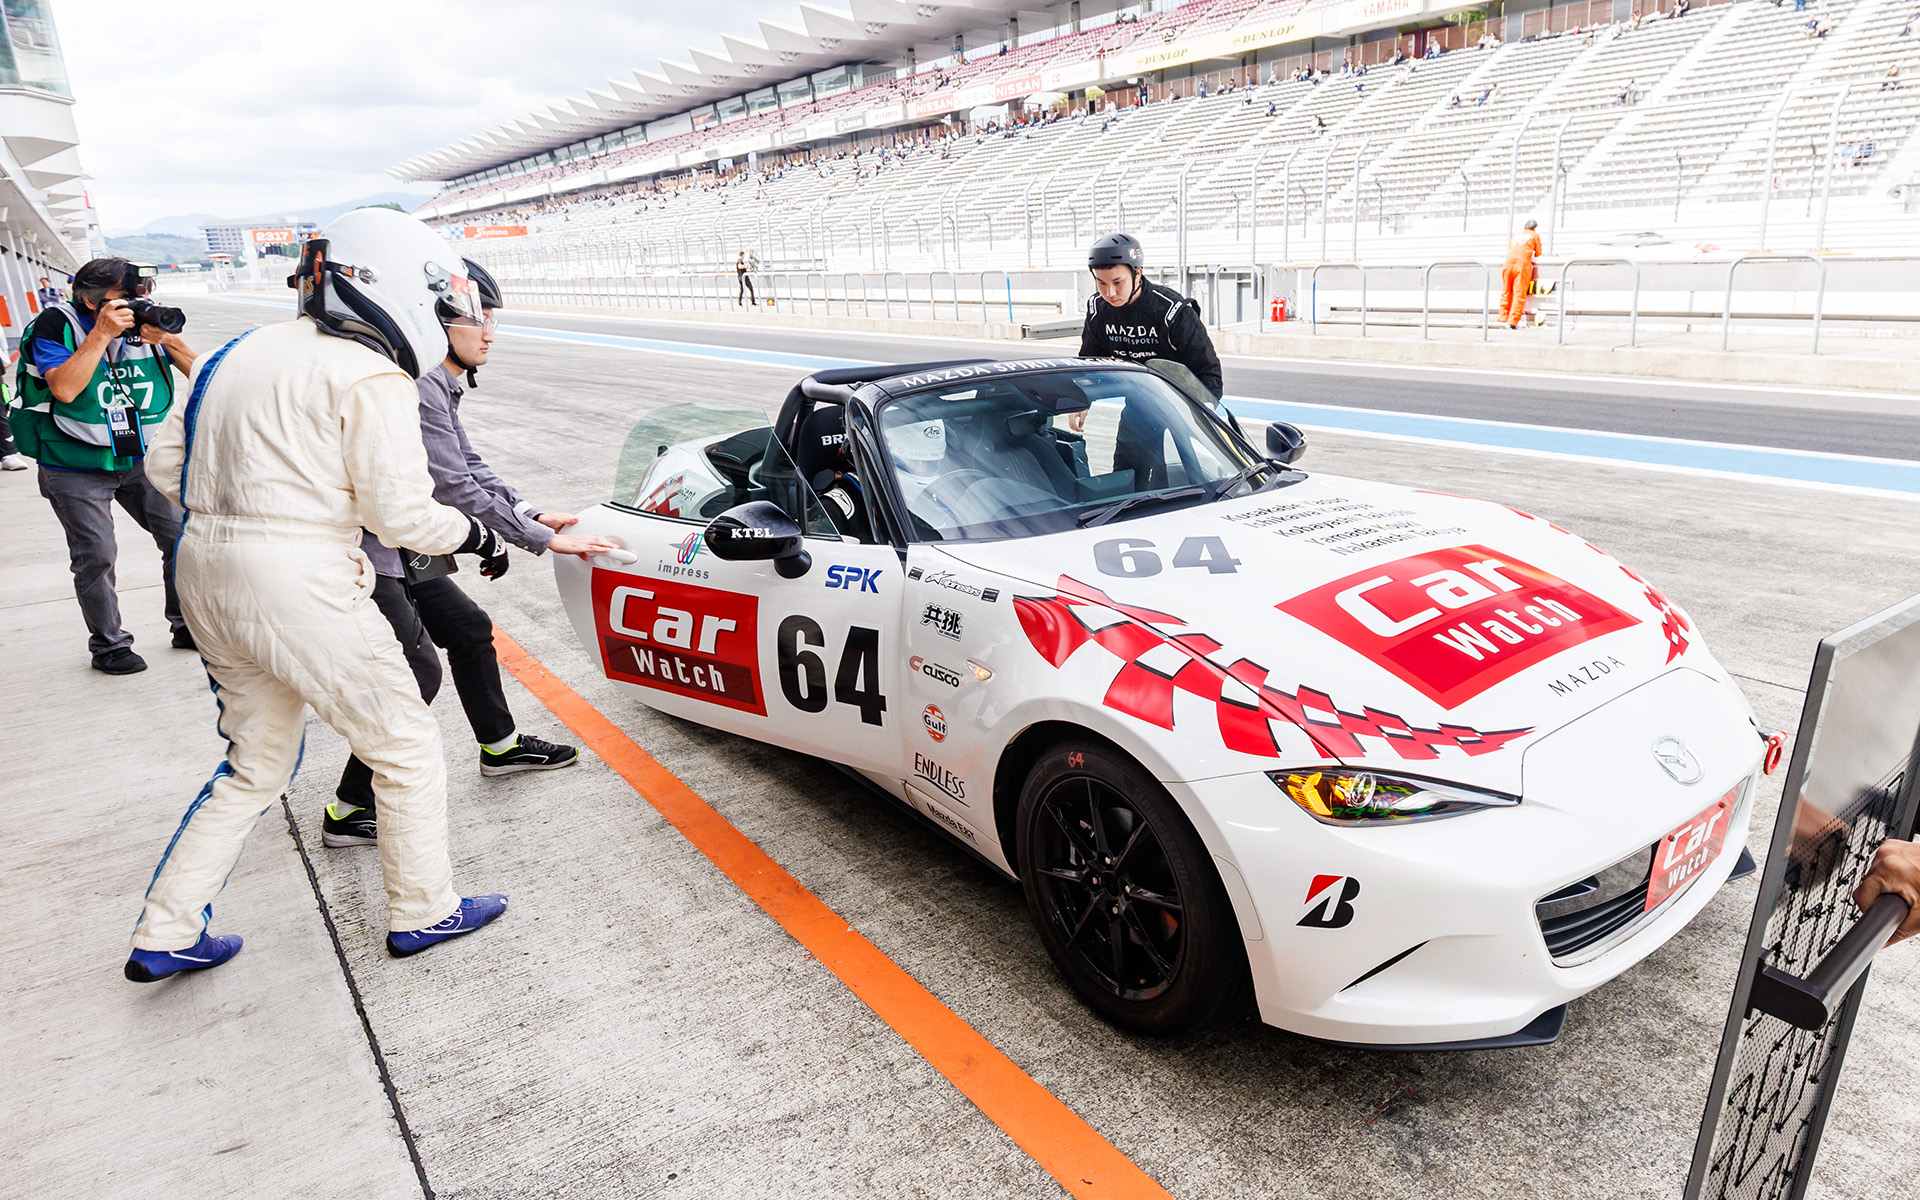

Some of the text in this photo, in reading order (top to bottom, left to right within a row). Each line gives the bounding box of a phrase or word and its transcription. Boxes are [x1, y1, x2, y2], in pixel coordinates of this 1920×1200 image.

[1362, 0, 1410, 17] YAMAHA
[1242, 24, 1295, 44] DUNLOP
[1144, 48, 1188, 65] DUNLOP
[996, 77, 1041, 99] NISSAN
[916, 97, 953, 115] NISSAN
[255, 231, 289, 242] 2317
[1105, 324, 1158, 338] MAZDA
[901, 366, 991, 388] MAZDA
[993, 359, 1058, 373] SPIRIT
[1220, 503, 1305, 522] Kusakabe
[1244, 510, 1320, 528] Ishikawa
[731, 527, 774, 539] KTEL
[1273, 515, 1362, 537] Kobayashi
[1304, 527, 1378, 545] Yamada
[1329, 532, 1418, 556] Nakanishi
[1093, 536, 1243, 578] 64
[658, 559, 709, 580] impress
[825, 563, 883, 594] SPK
[1334, 558, 1524, 638] Car
[609, 585, 738, 655] Car
[1432, 596, 1584, 662] Watch
[631, 645, 726, 693] Watch
[777, 614, 887, 727] 64
[923, 664, 960, 687] CUSCO
[1547, 655, 1625, 698] MAZDA
[924, 713, 947, 734] Gulf
[1068, 752, 1085, 768] 64
[915, 752, 966, 799] ENDLESS
[1663, 809, 1724, 871] Car
[1667, 846, 1709, 889] Watch
